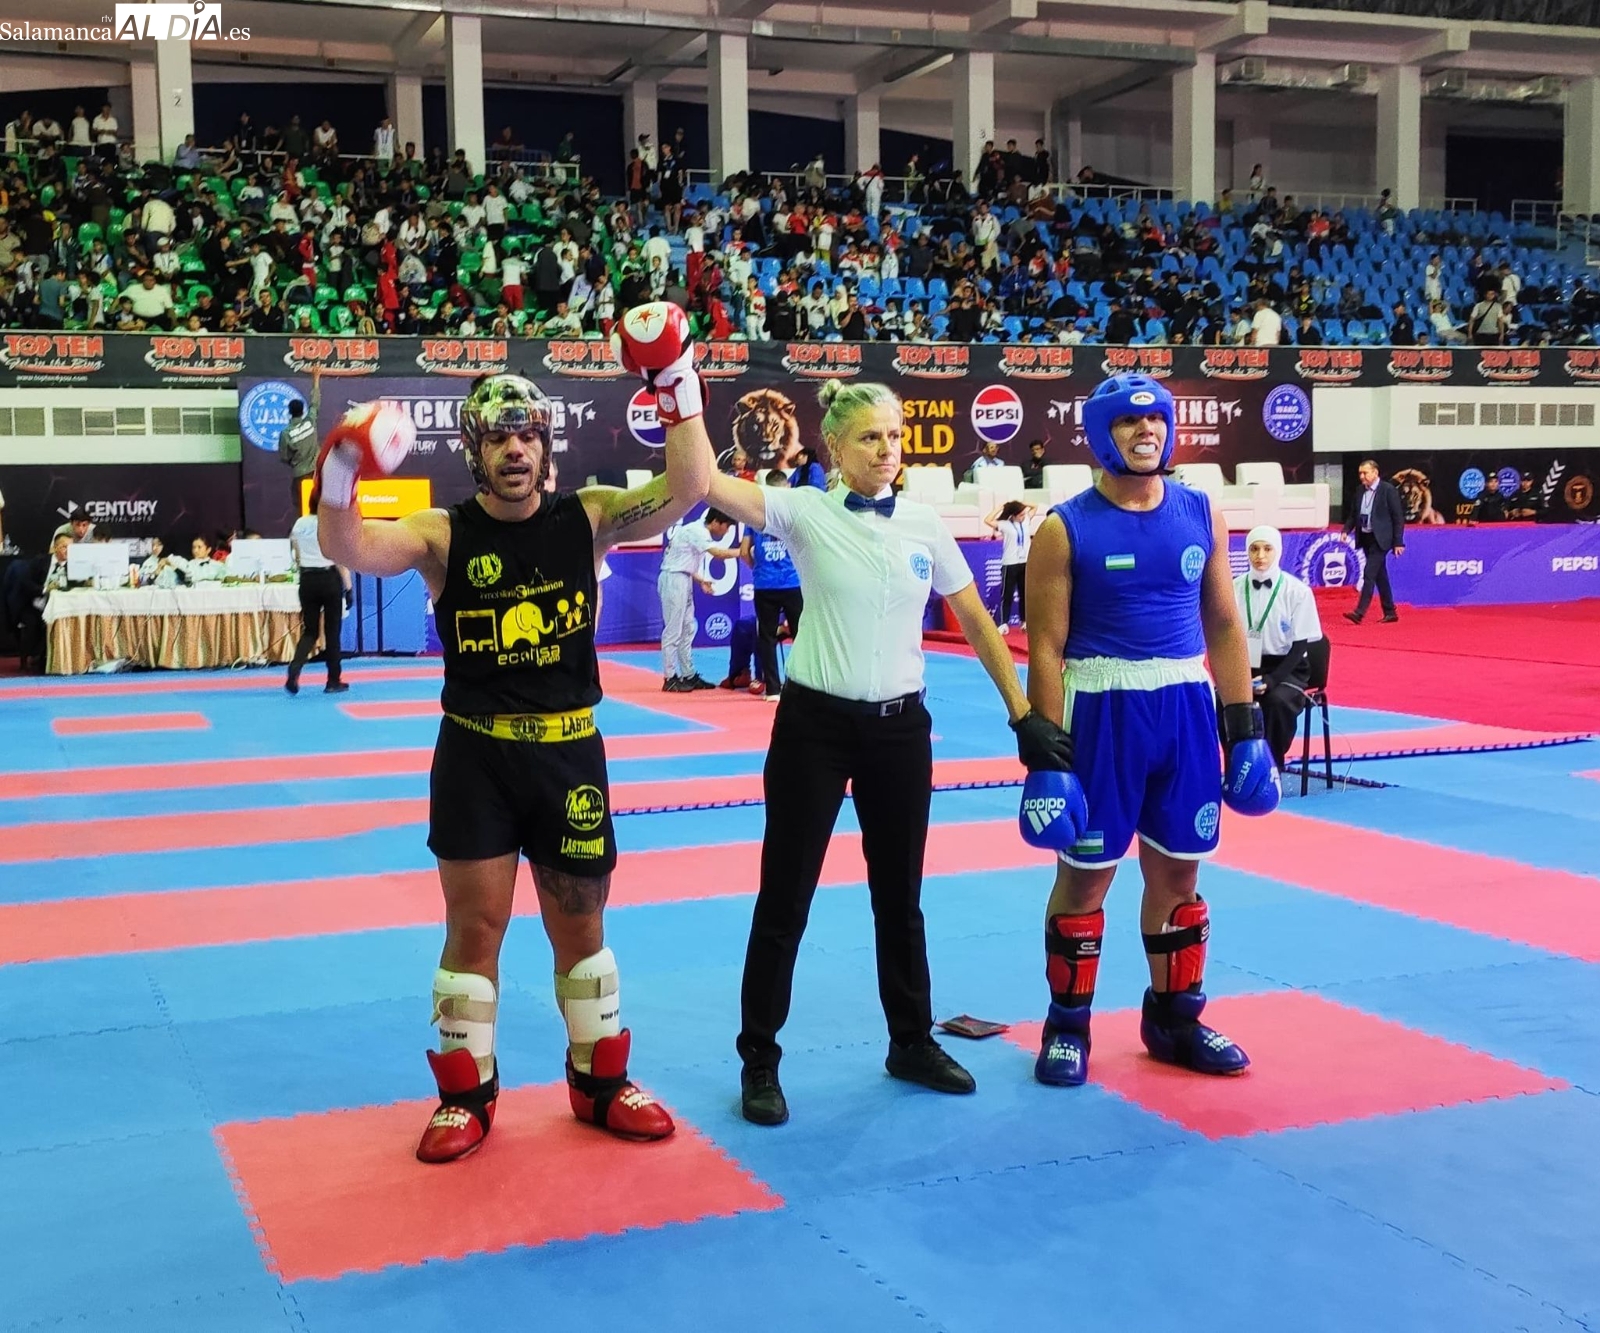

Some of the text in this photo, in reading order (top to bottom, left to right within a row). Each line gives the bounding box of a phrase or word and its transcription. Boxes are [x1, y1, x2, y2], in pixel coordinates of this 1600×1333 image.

[4, 335, 104, 357] TOP TEN
[150, 337, 245, 359] TOP TEN
[289, 338, 380, 360] TOP TEN
[422, 340, 508, 361] TOP TEN
[588, 341, 616, 362] TE
[976, 408, 1019, 420] PEPSI
[901, 424, 955, 454] RLD
[85, 500, 158, 516] CENTURY
[1434, 560, 1483, 576] PEPSI
[1552, 556, 1598, 572] PEPSI
[1024, 798, 1066, 812] adidas
[561, 835, 604, 856] LASTROUND
